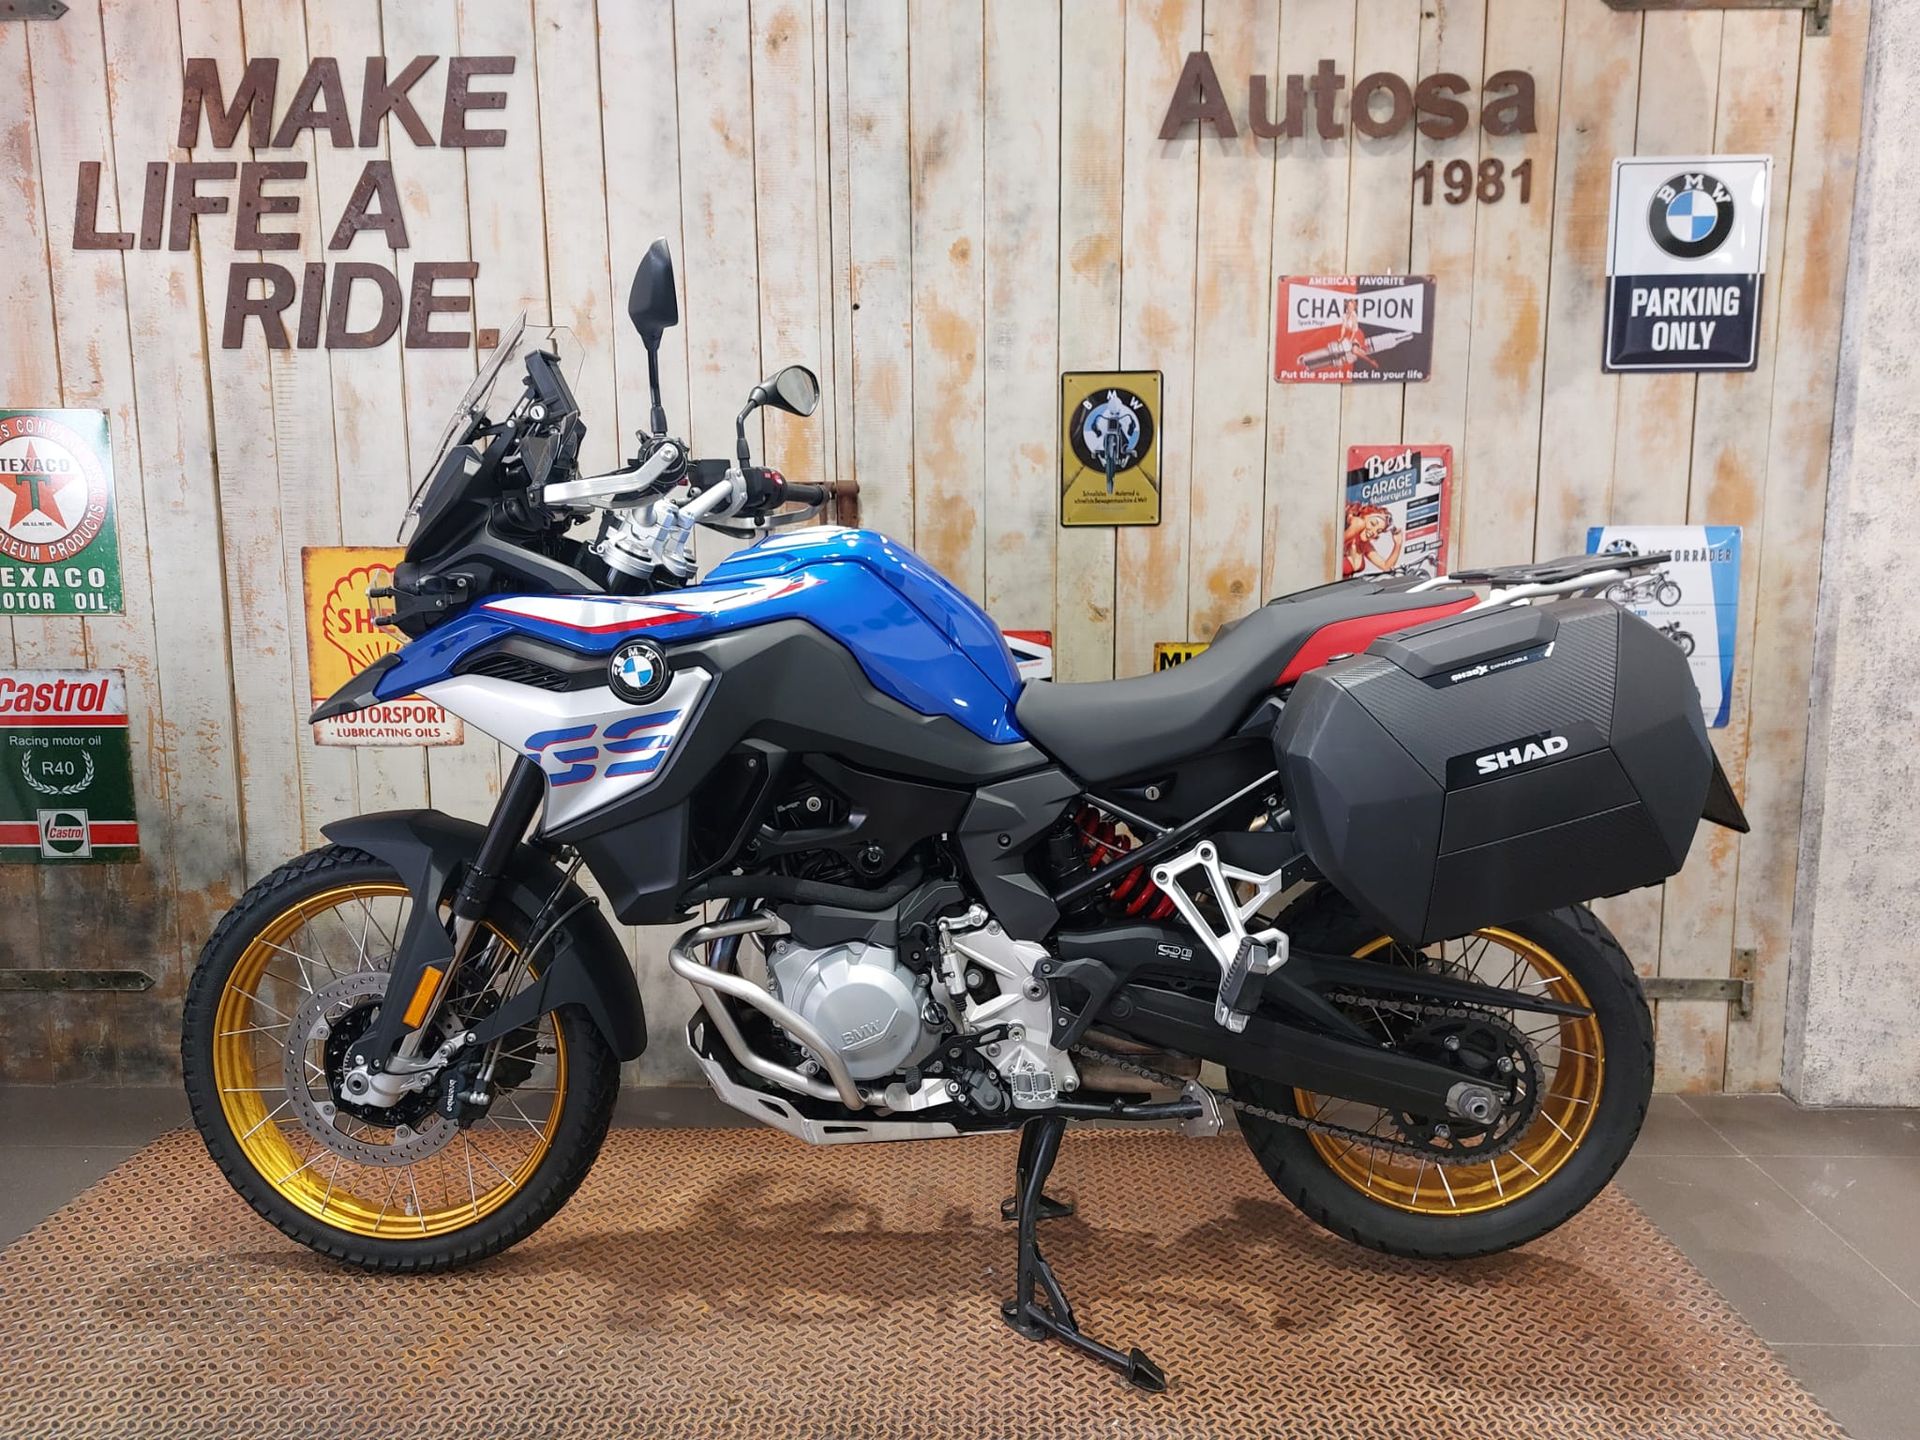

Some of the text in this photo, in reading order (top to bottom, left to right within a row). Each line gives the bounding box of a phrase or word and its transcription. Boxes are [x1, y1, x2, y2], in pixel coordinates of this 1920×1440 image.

[178, 55, 516, 148] MAKE
[1158, 51, 1538, 140] Autosa
[1412, 158, 1533, 206] 1981
[1656, 173, 1732, 205] BMW
[73, 160, 409, 250] LIFE A
[1359, 276, 1405, 286] FAVORITE
[222, 261, 500, 349] RIDE.
[1631, 286, 1741, 317] PARKING
[1651, 321, 1716, 351] ONLY
[1281, 369, 1424, 381] Put the spark back in your life
[1082, 389, 1144, 410] BMW
[0, 458, 71, 472] TEXACO
[1364, 448, 1414, 480] Best
[1362, 473, 1413, 499] GARAGE
[48, 503, 105, 560] PRODUCTS
[0, 567, 106, 588] EXACO
[2, 592, 108, 609] OTOR OIL
[337, 608, 397, 634] SHE
[0, 677, 110, 713] Castrol
[9, 735, 102, 748] Racing motor oil
[336, 728, 441, 738] LUBRICATING OILS
[41, 761, 75, 776] R40
[1475, 735, 1568, 775] SHAD
[49, 827, 84, 839] Castrol
[840, 1019, 880, 1045] BMW
[446, 1079, 458, 1112] brembo
